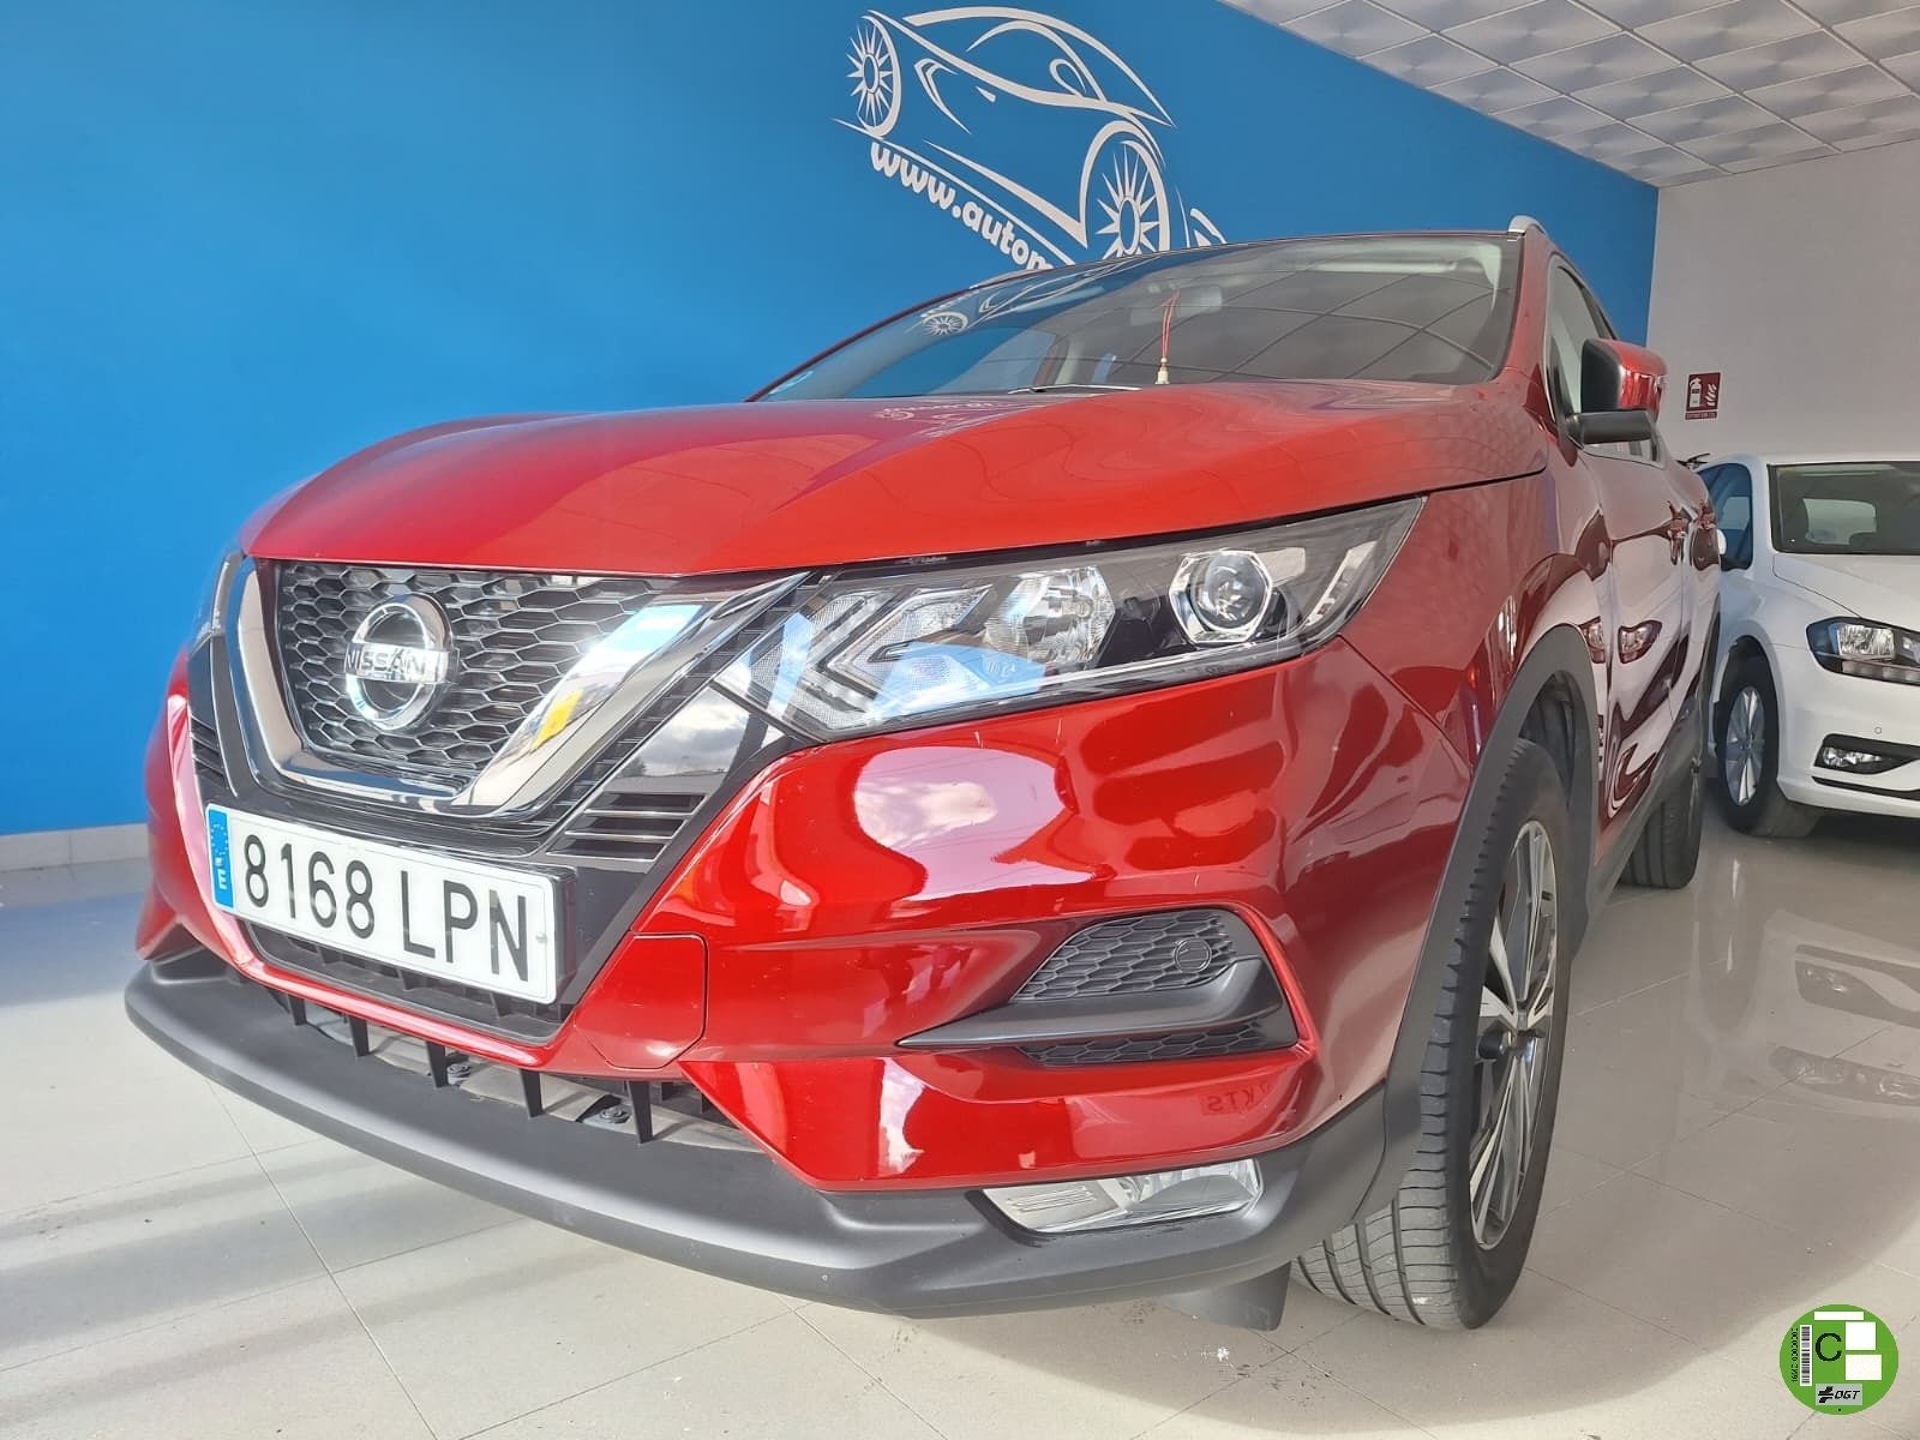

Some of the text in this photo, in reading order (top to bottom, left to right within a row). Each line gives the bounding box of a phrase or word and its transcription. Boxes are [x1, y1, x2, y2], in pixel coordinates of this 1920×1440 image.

[346, 647, 428, 677] NISSAN
[243, 834, 529, 982] 8168 LPN
